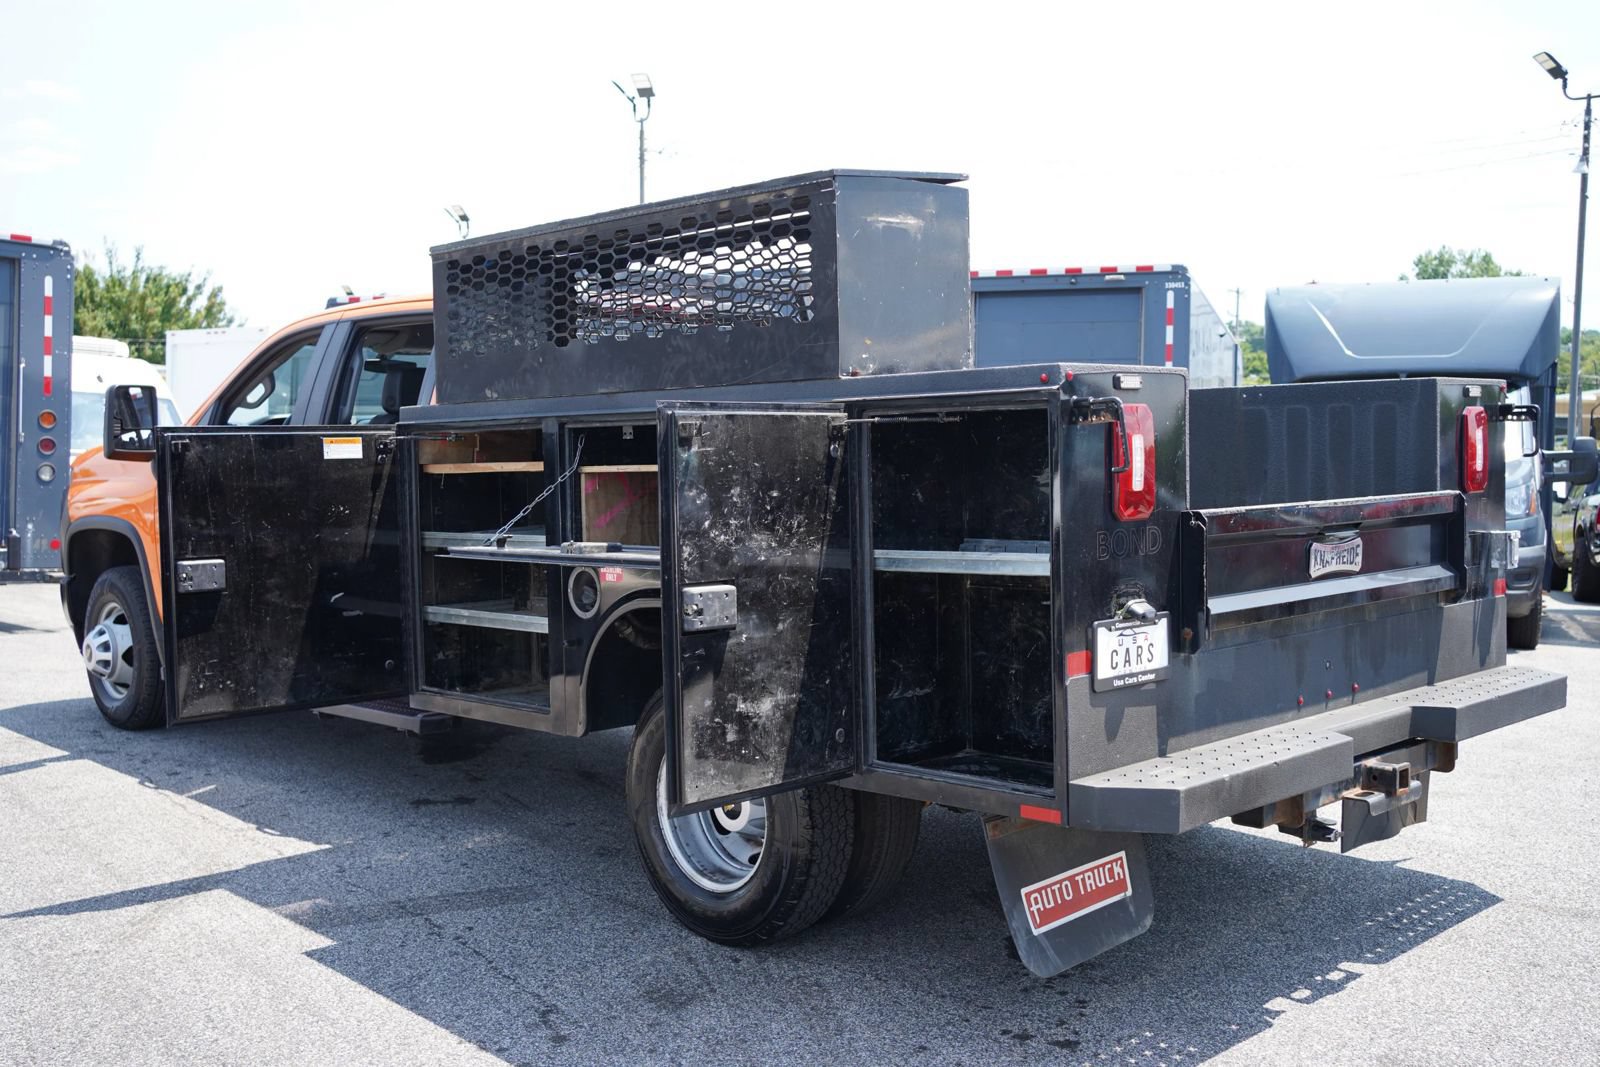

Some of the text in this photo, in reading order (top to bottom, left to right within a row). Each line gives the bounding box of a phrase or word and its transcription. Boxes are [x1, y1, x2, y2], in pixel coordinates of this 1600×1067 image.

[1096, 526, 1162, 560] BOND
[606, 573, 617, 582] ONLY
[1110, 643, 1155, 670] CARS
[1113, 673, 1156, 687] Usa Cars Center
[1030, 860, 1124, 925] AUTO TRUCK
